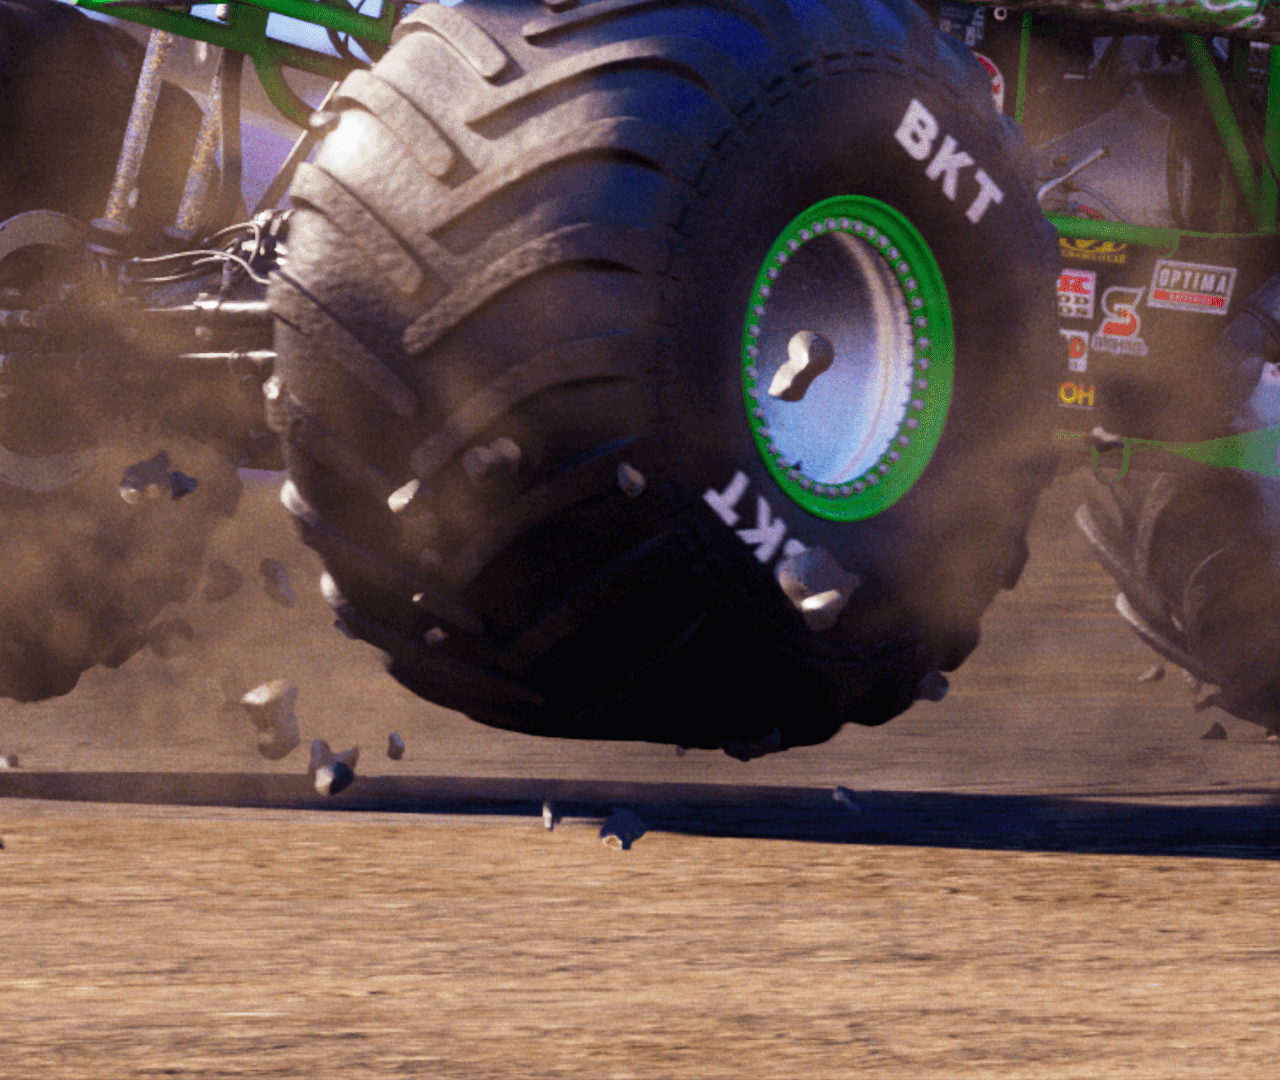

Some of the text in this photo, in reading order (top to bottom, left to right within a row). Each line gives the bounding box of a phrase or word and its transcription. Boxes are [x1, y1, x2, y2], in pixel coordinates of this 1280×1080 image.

[894, 98, 1004, 224] BKT
[1158, 267, 1228, 293] OPTIMA
[704, 470, 807, 564] KT
